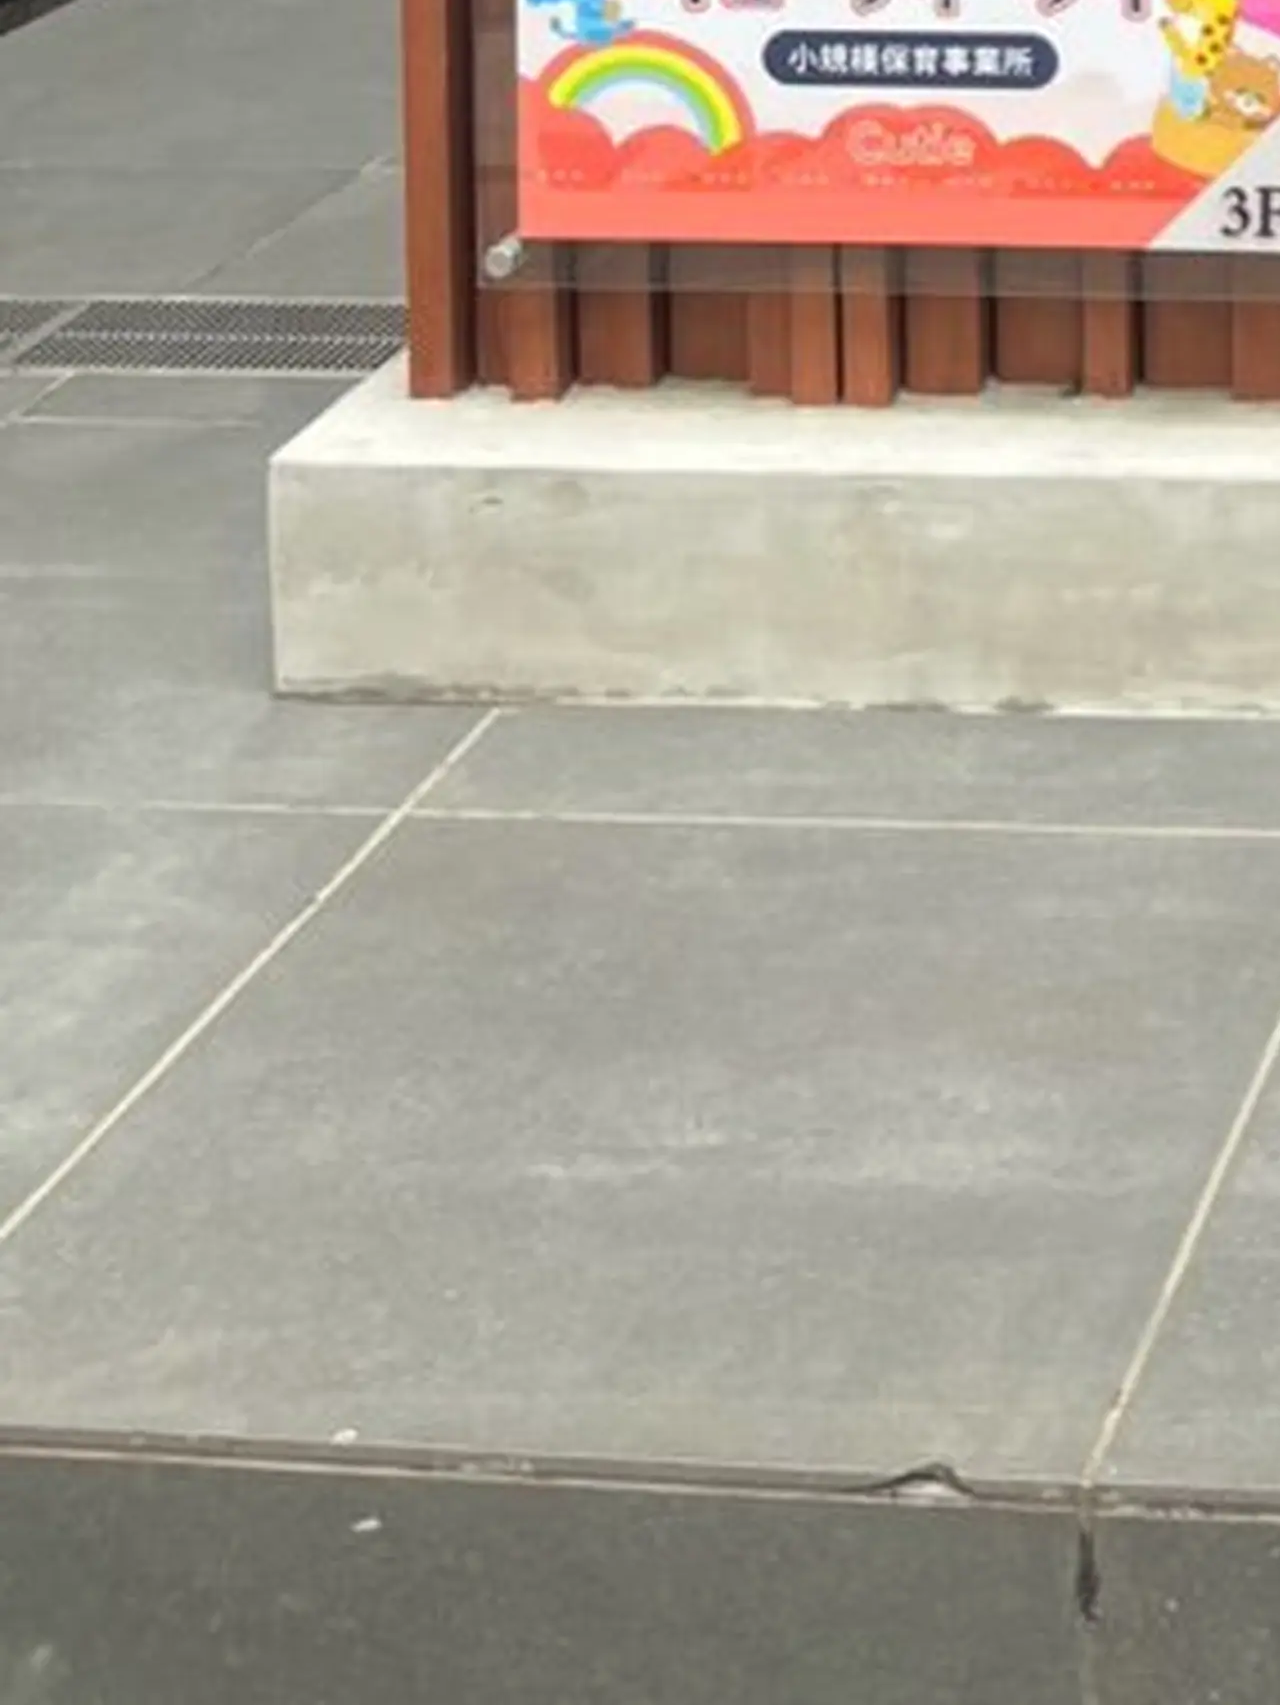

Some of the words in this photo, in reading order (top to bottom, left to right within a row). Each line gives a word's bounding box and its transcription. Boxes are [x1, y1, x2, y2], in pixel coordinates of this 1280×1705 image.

[788, 43, 1034, 76] 小規模保育事業所
